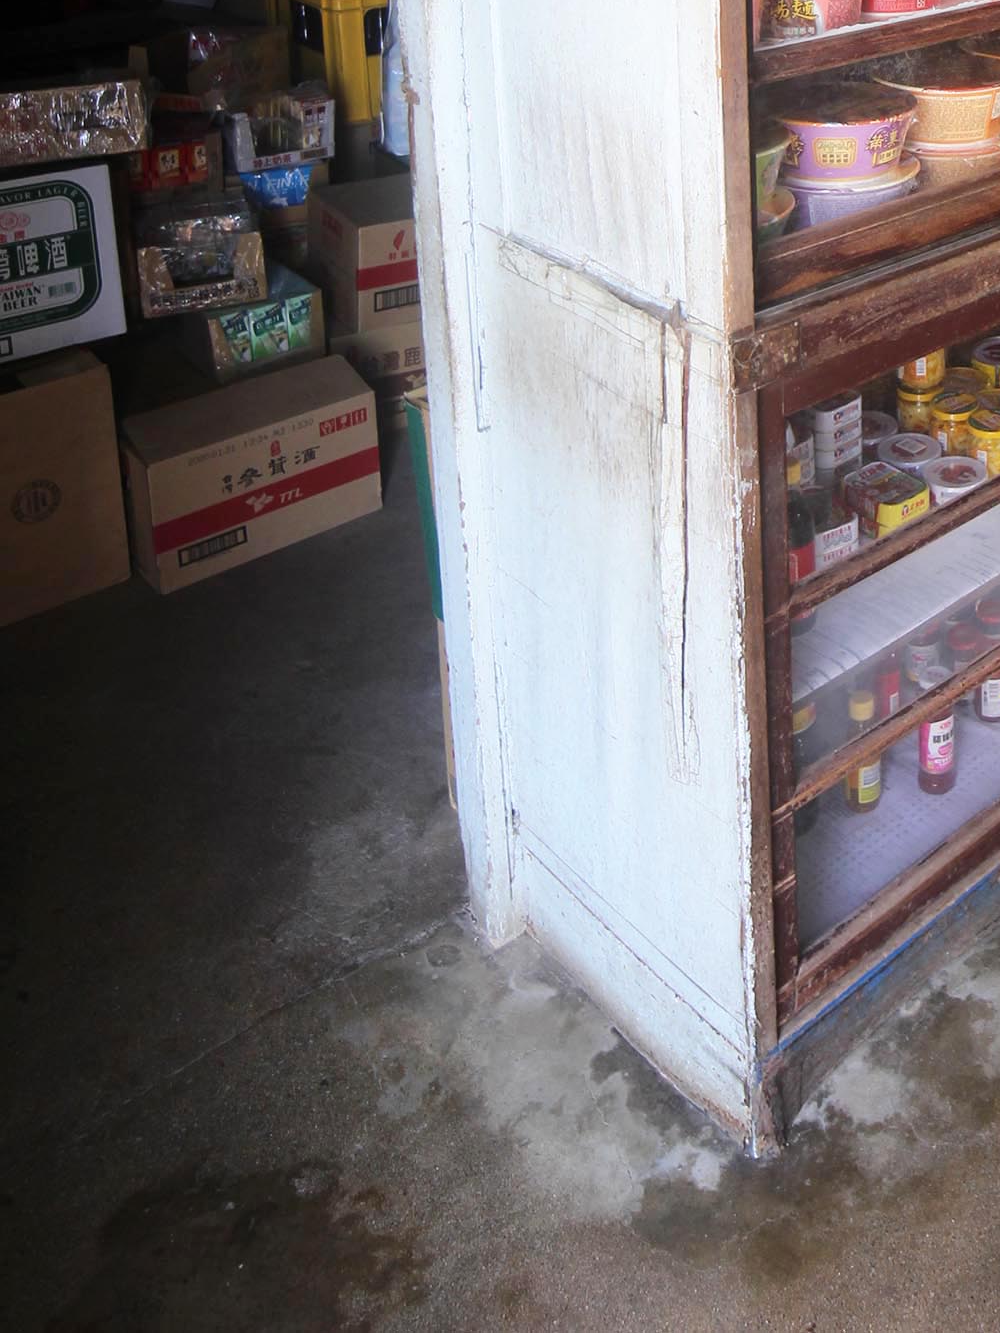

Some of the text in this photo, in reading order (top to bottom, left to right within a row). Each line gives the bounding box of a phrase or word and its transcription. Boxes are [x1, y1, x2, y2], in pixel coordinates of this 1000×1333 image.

[0, 285, 42, 302] AIWAN
[3, 297, 38, 313] BEER
[278, 487, 303, 504] TTL
